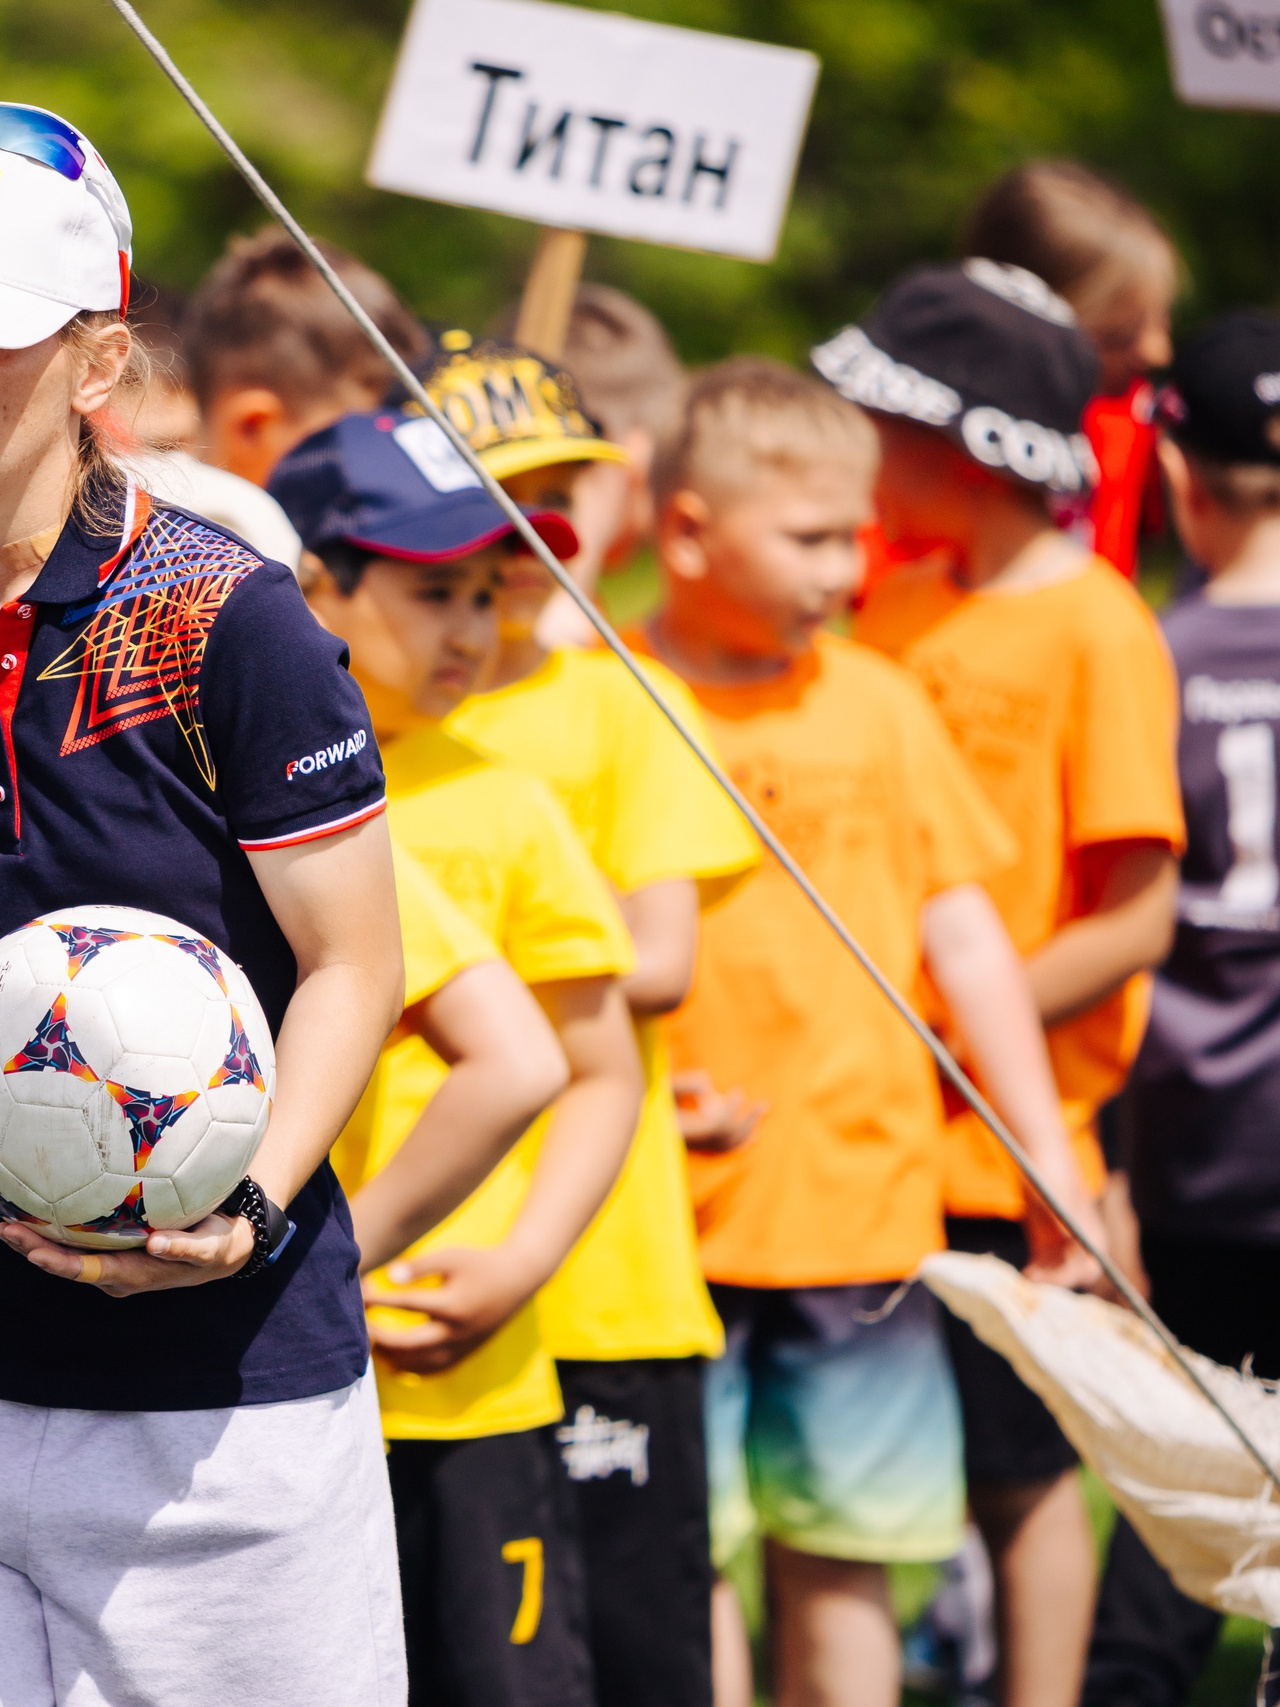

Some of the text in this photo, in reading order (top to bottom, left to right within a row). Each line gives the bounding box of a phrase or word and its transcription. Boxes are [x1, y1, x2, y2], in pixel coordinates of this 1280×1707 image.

[469, 61, 739, 210] Титан
[286, 729, 367, 781] FORWARD
[500, 1536, 545, 1645] 7
